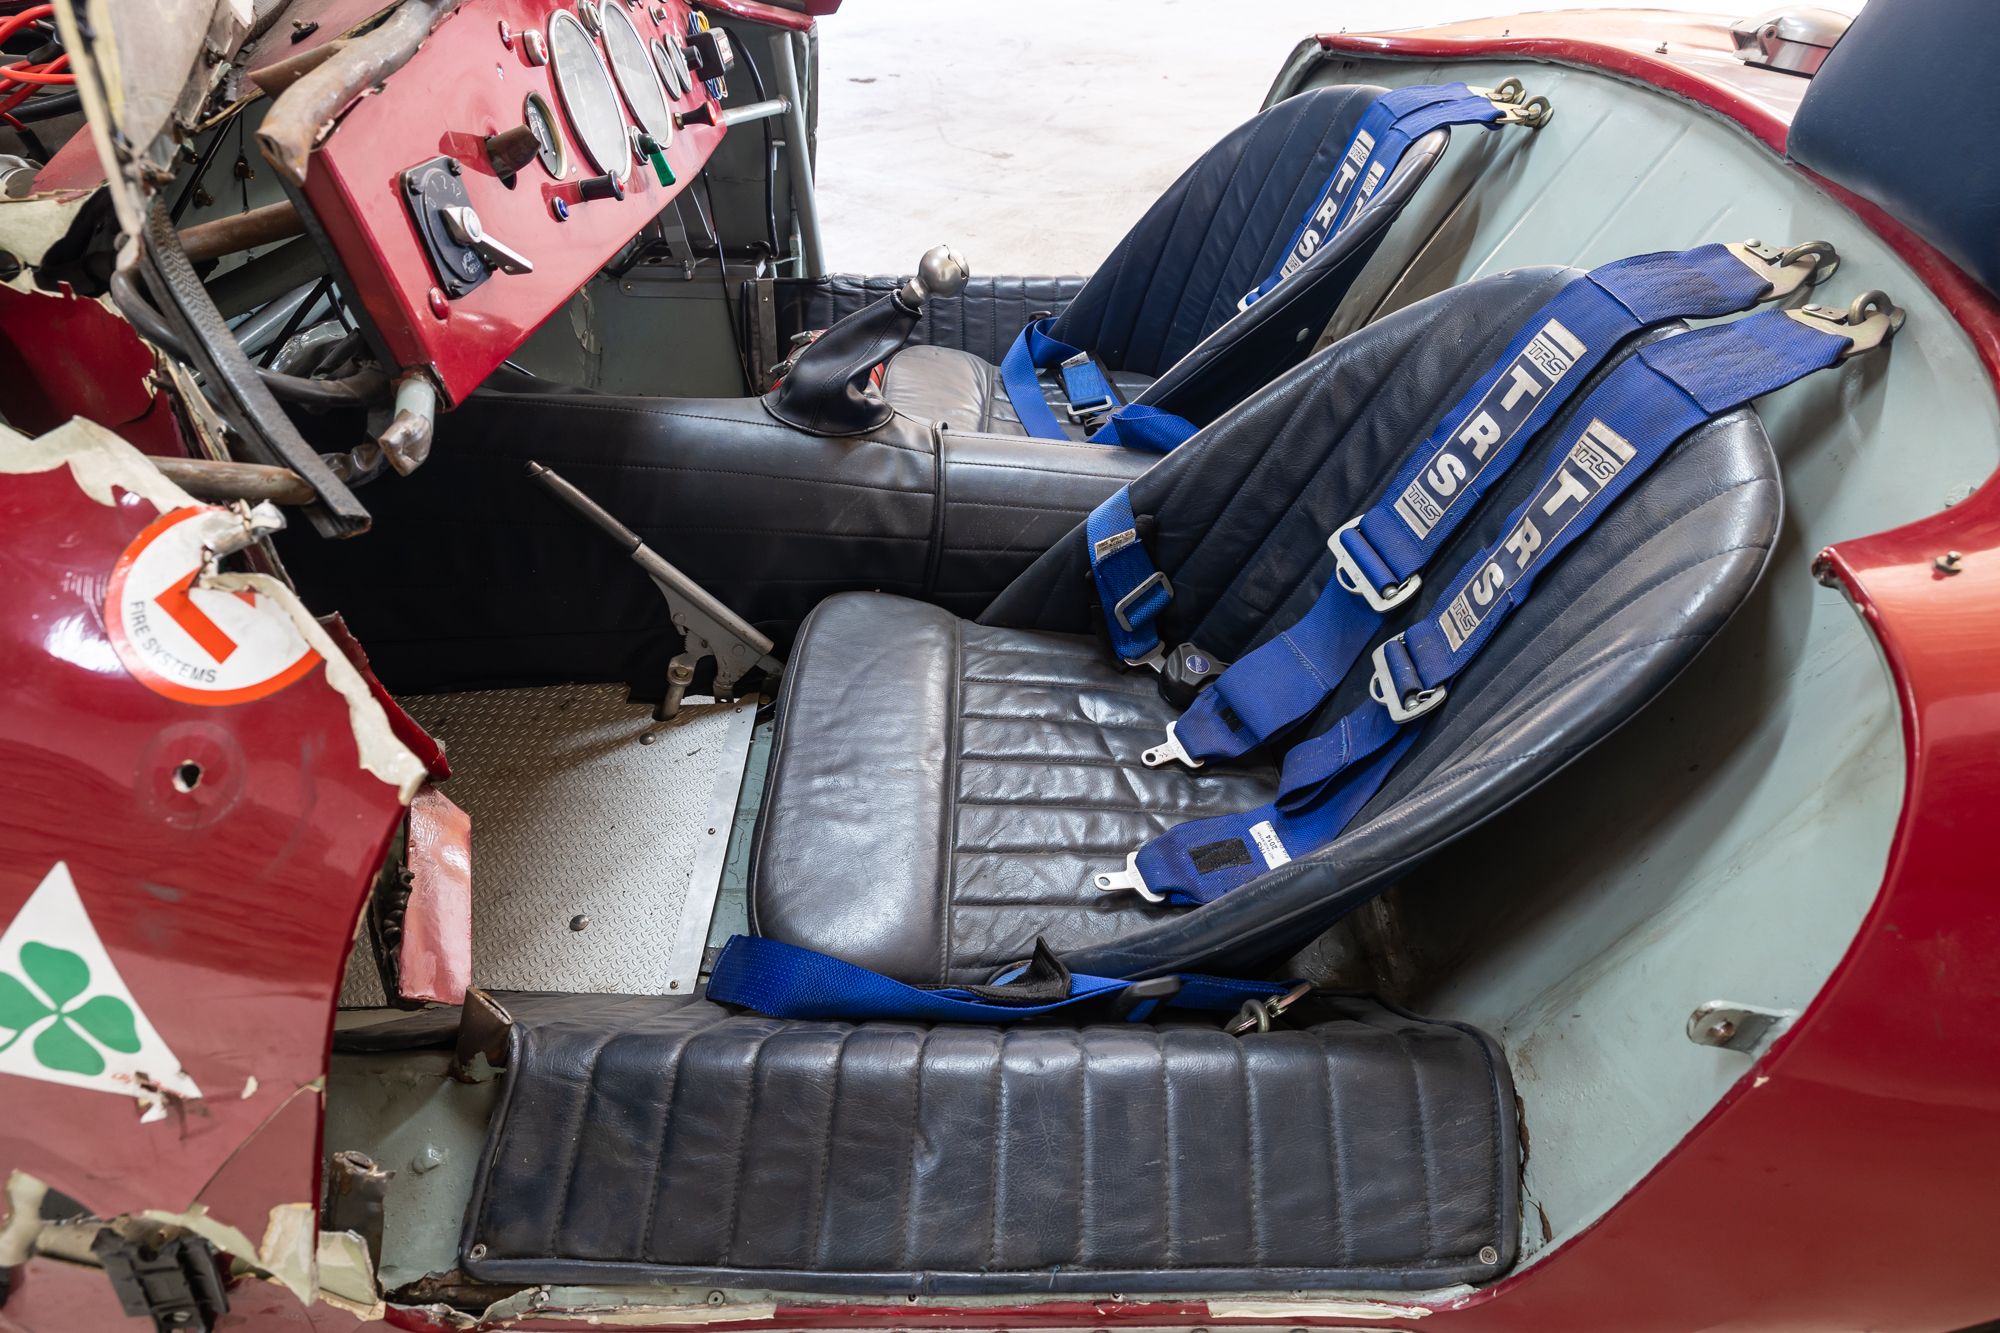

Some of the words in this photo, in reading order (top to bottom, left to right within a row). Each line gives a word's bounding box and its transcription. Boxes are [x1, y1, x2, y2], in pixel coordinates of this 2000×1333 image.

[1528, 338, 1568, 376] TRS
[1427, 364, 1543, 497] TRS
[1572, 440, 1617, 480] TRS
[1408, 483, 1441, 521] TRS
[1472, 468, 1590, 606] TRS
[1452, 596, 1478, 632] TRS
[130, 601, 150, 637] FIRE
[142, 637, 217, 684] SYSTEMS
[1265, 834, 1278, 850] 2014
